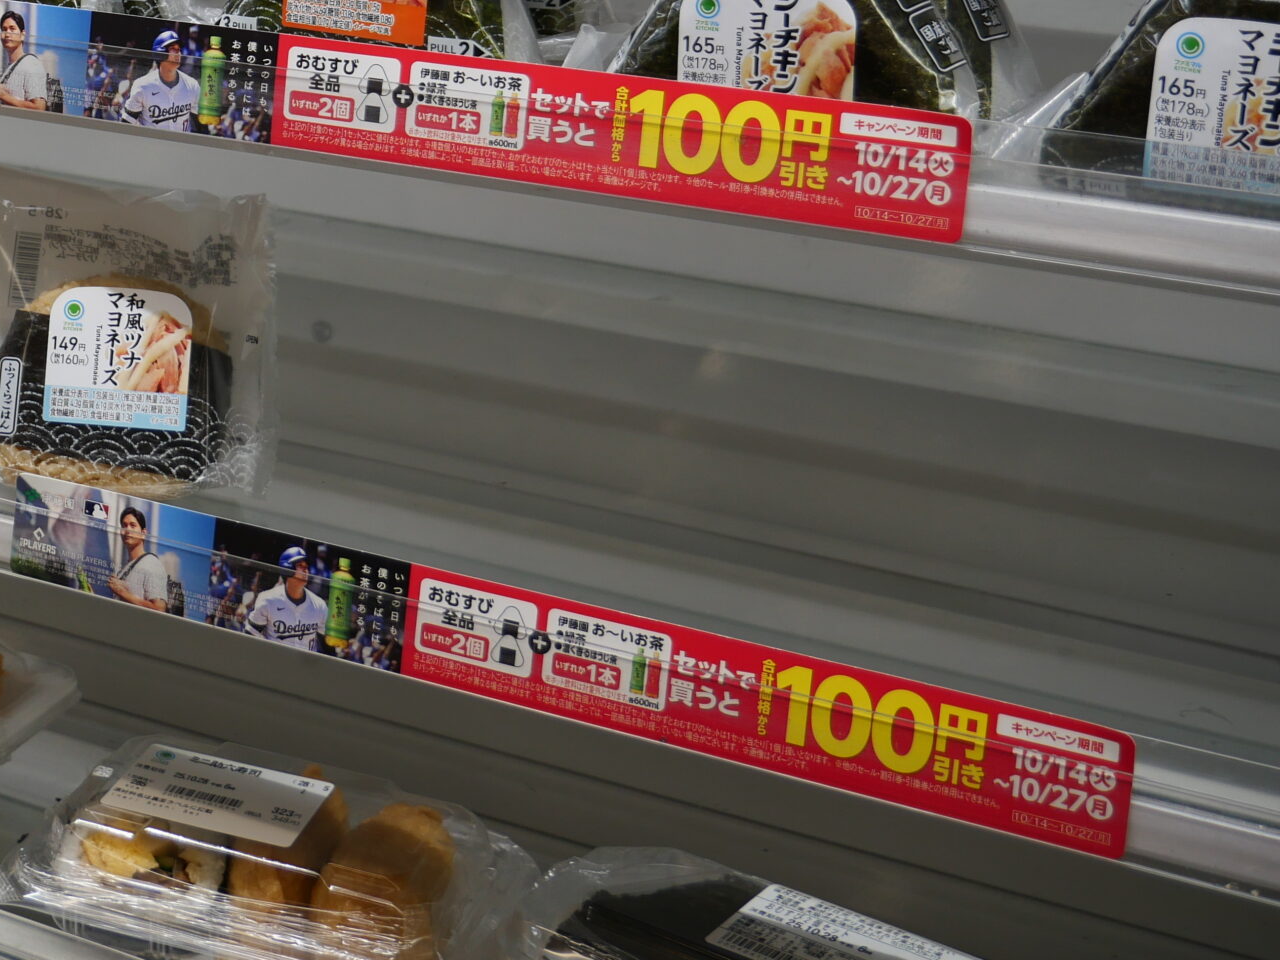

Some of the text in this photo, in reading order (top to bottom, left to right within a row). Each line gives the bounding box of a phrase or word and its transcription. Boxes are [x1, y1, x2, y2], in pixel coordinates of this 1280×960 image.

[682, 35, 725, 55] 165円
[736, 25, 744, 46] Tuna
[430, 43, 456, 54] PULL
[295, 53, 359, 76] おむすび
[419, 68, 450, 82] 伊藤園
[308, 74, 341, 93] 全品
[1158, 75, 1207, 100] 165円
[1225, 28, 1265, 153] マヨネーズ
[148, 101, 192, 125] Dodgers
[532, 88, 610, 119] セットで
[1215, 70, 1232, 148] Tuna Mayonnaise
[527, 116, 596, 148] 買うと
[853, 119, 943, 141] キャンペーン期間
[1154, 115, 1207, 132] 栄養成分表示
[778, 159, 829, 190] 引き
[95, 324, 103, 343] Tuna
[101, 290, 126, 387] マヨネーズ
[122, 292, 146, 370] 和風ツナ
[51, 336, 86, 352] 149円
[0, 362, 15, 431] ふっくらごはん
[427, 585, 494, 615] おむすび
[272, 618, 319, 642] Dodgers
[441, 610, 475, 632] 全品
[673, 649, 757, 689] セットで
[668, 679, 741, 718] 買うと
